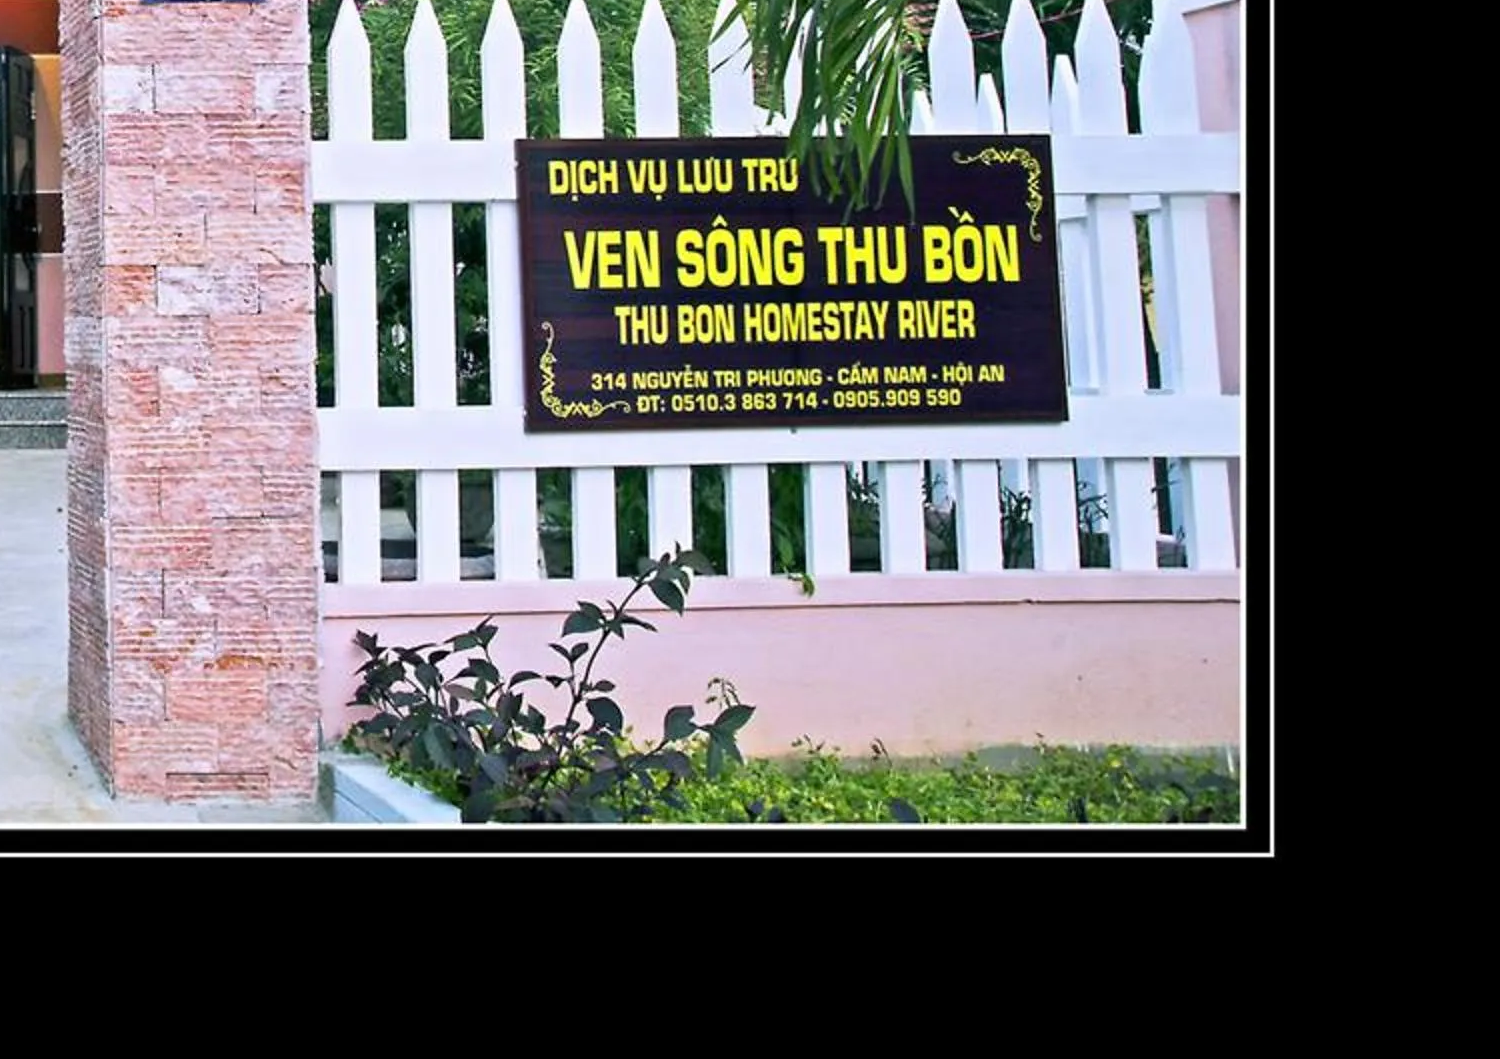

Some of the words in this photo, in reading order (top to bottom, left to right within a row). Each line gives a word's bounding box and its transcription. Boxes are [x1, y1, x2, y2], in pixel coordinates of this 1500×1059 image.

[548, 159, 619, 202] DỊCH
[627, 159, 668, 202] VỤ
[564, 230, 661, 289] VEN
[675, 214, 805, 288] SÔNG
[817, 226, 908, 285] THU
[922, 206, 1021, 283] BỒN
[614, 304, 670, 345] THU
[677, 304, 736, 344] BON
[743, 300, 890, 343] HOMESTAY
[897, 299, 977, 340] RIVER
[591, 372, 627, 391] 314
[883, 365, 928, 384] NAM
[942, 360, 974, 387] HỘI
[977, 364, 1006, 383] AN
[636, 394, 666, 414] ĐT:
[671, 392, 737, 413] 0510.3
[741, 391, 778, 411] 863
[782, 391, 818, 410] 714
[833, 388, 921, 409] 0905.909
[925, 388, 962, 407] 590
